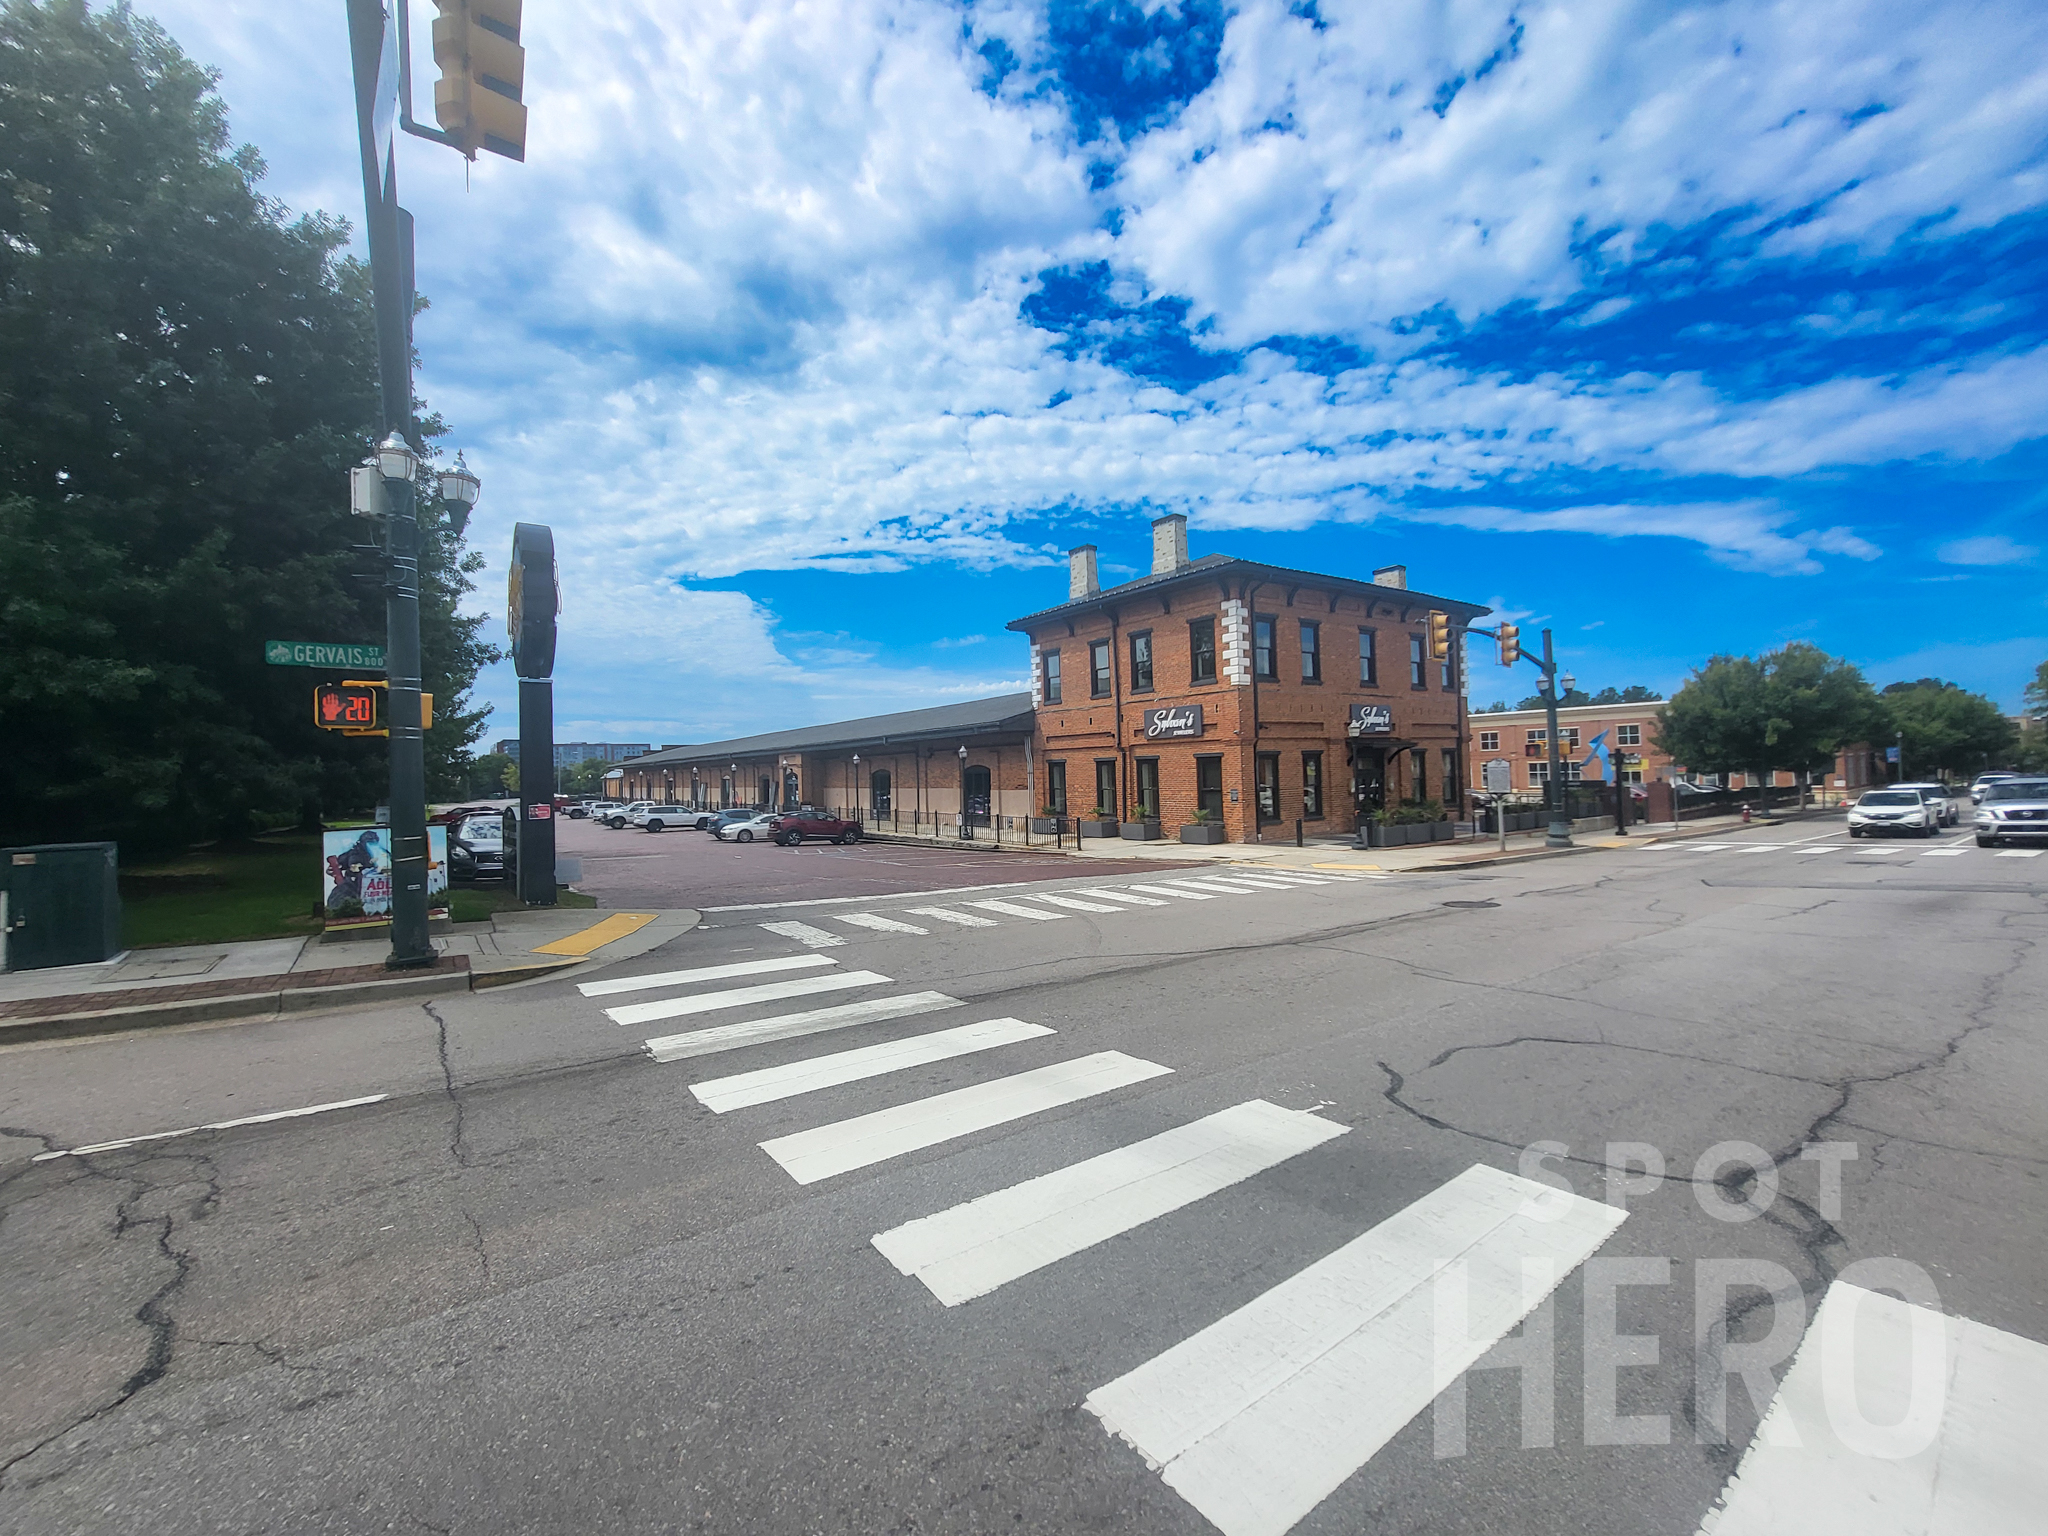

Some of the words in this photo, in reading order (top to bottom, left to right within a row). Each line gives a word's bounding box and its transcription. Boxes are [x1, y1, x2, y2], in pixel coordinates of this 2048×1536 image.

[294, 645, 363, 664] GERVAIS
[368, 647, 379, 656] ST
[364, 657, 384, 666] 800
[345, 697, 370, 721] 20
[1148, 708, 1195, 737] Sylvan's
